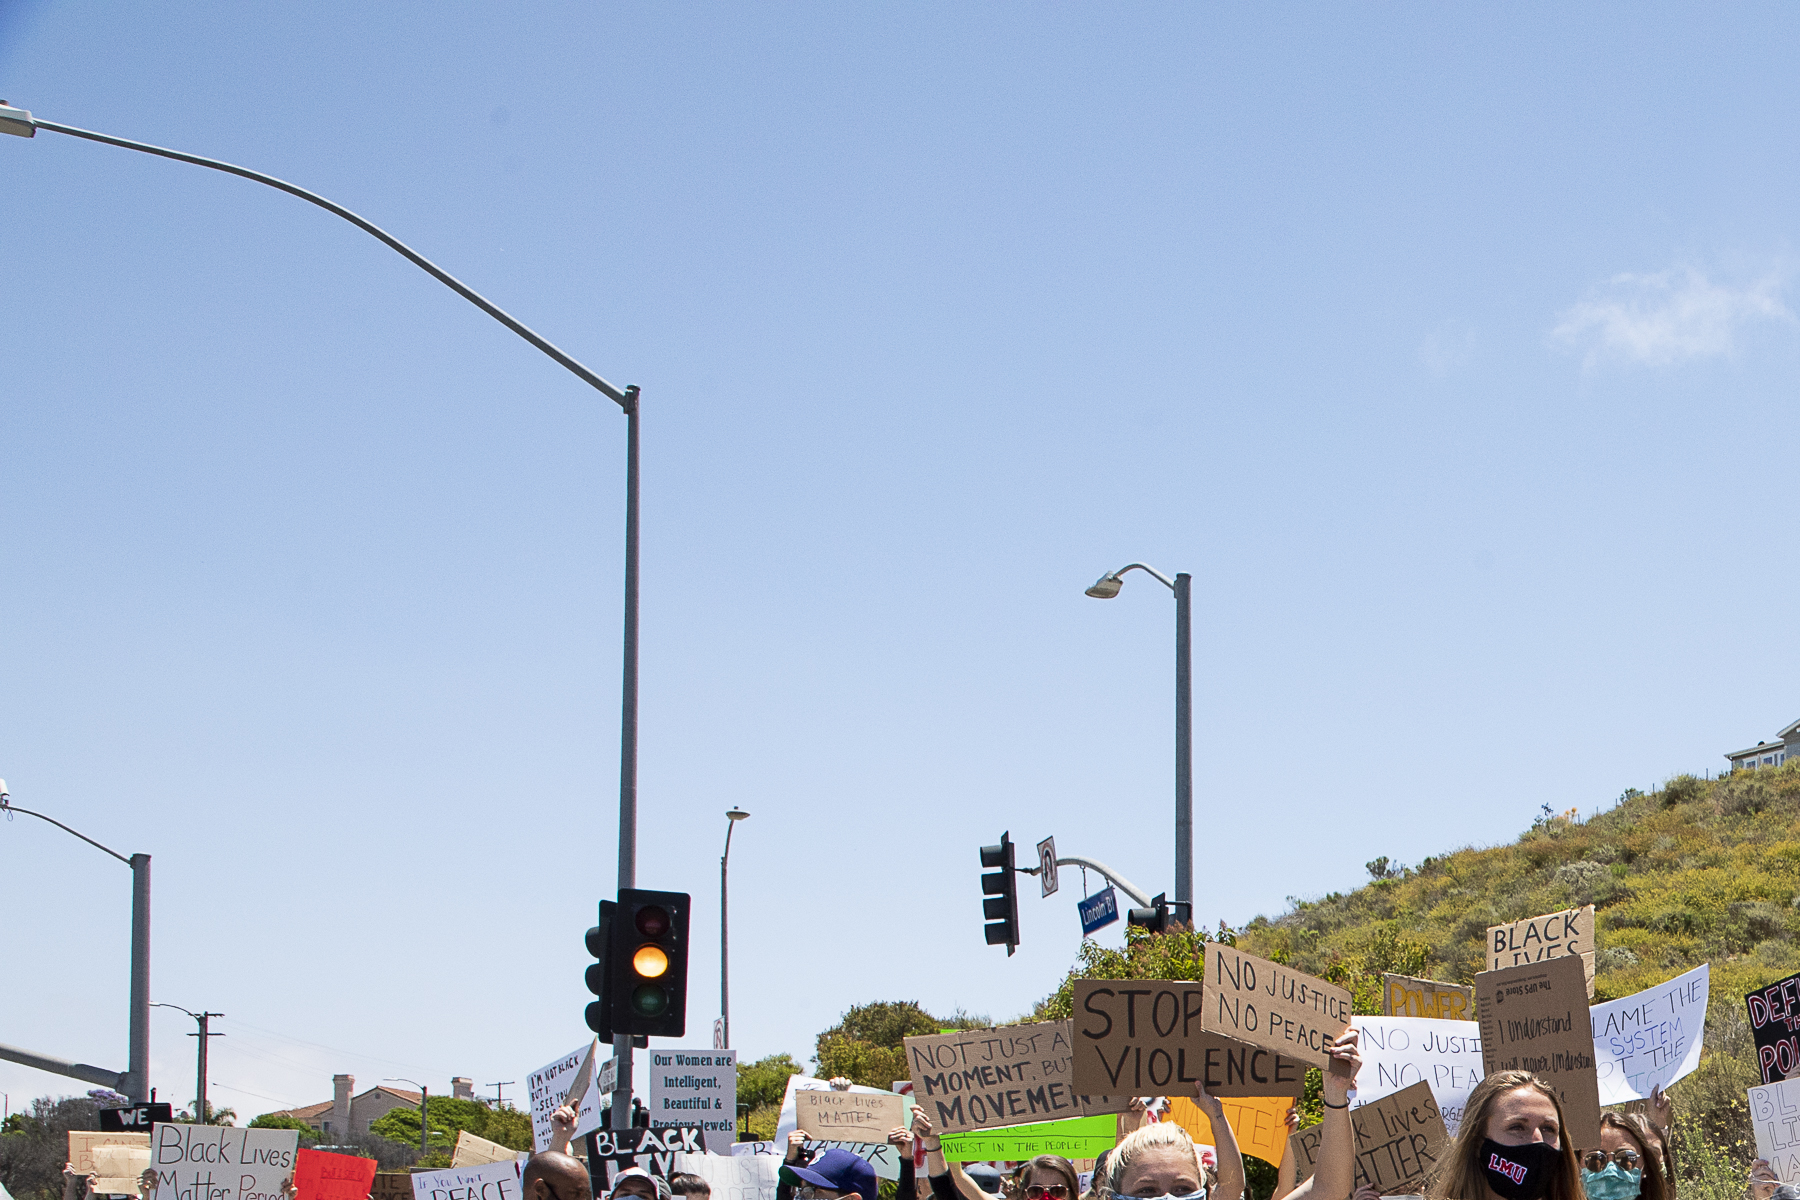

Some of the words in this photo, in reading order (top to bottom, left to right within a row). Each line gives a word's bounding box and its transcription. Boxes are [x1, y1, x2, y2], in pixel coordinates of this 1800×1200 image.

[1494, 912, 1580, 953] BLACK
[1217, 950, 1256, 992] NO
[1264, 968, 1350, 1024] JUSTICE
[1662, 977, 1703, 1014] THE
[1083, 988, 1202, 1040] STOP
[1217, 991, 1258, 1033] NO
[1269, 1011, 1336, 1055] PEACE
[911, 1040, 975, 1073] NOT
[980, 1033, 1043, 1062] JUST
[1052, 1031, 1070, 1052] A
[1362, 1025, 1410, 1051] NO
[1643, 1035, 1686, 1067] THE
[654, 1054, 673, 1066] Our
[675, 1054, 713, 1066] Women
[715, 1056, 733, 1067] are
[1094, 1043, 1298, 1089] VIOLENCE
[1378, 1062, 1422, 1089] NO
[664, 1076, 722, 1091] Intelligent,
[117, 1108, 150, 1127] WE
[663, 1097, 711, 1110] Beautiful
[714, 1098, 723, 1110] &
[817, 1110, 882, 1125] MATTER
[935, 1081, 1110, 1129] MOVEMEN
[158, 1124, 232, 1165] Black
[239, 1129, 292, 1169] Lives
[595, 1127, 702, 1158] BLACK
[942, 1140, 986, 1155] INVEST
[992, 1140, 1005, 1152] IN
[1013, 1141, 1040, 1152] THE
[1487, 1152, 1529, 1187] LMU
